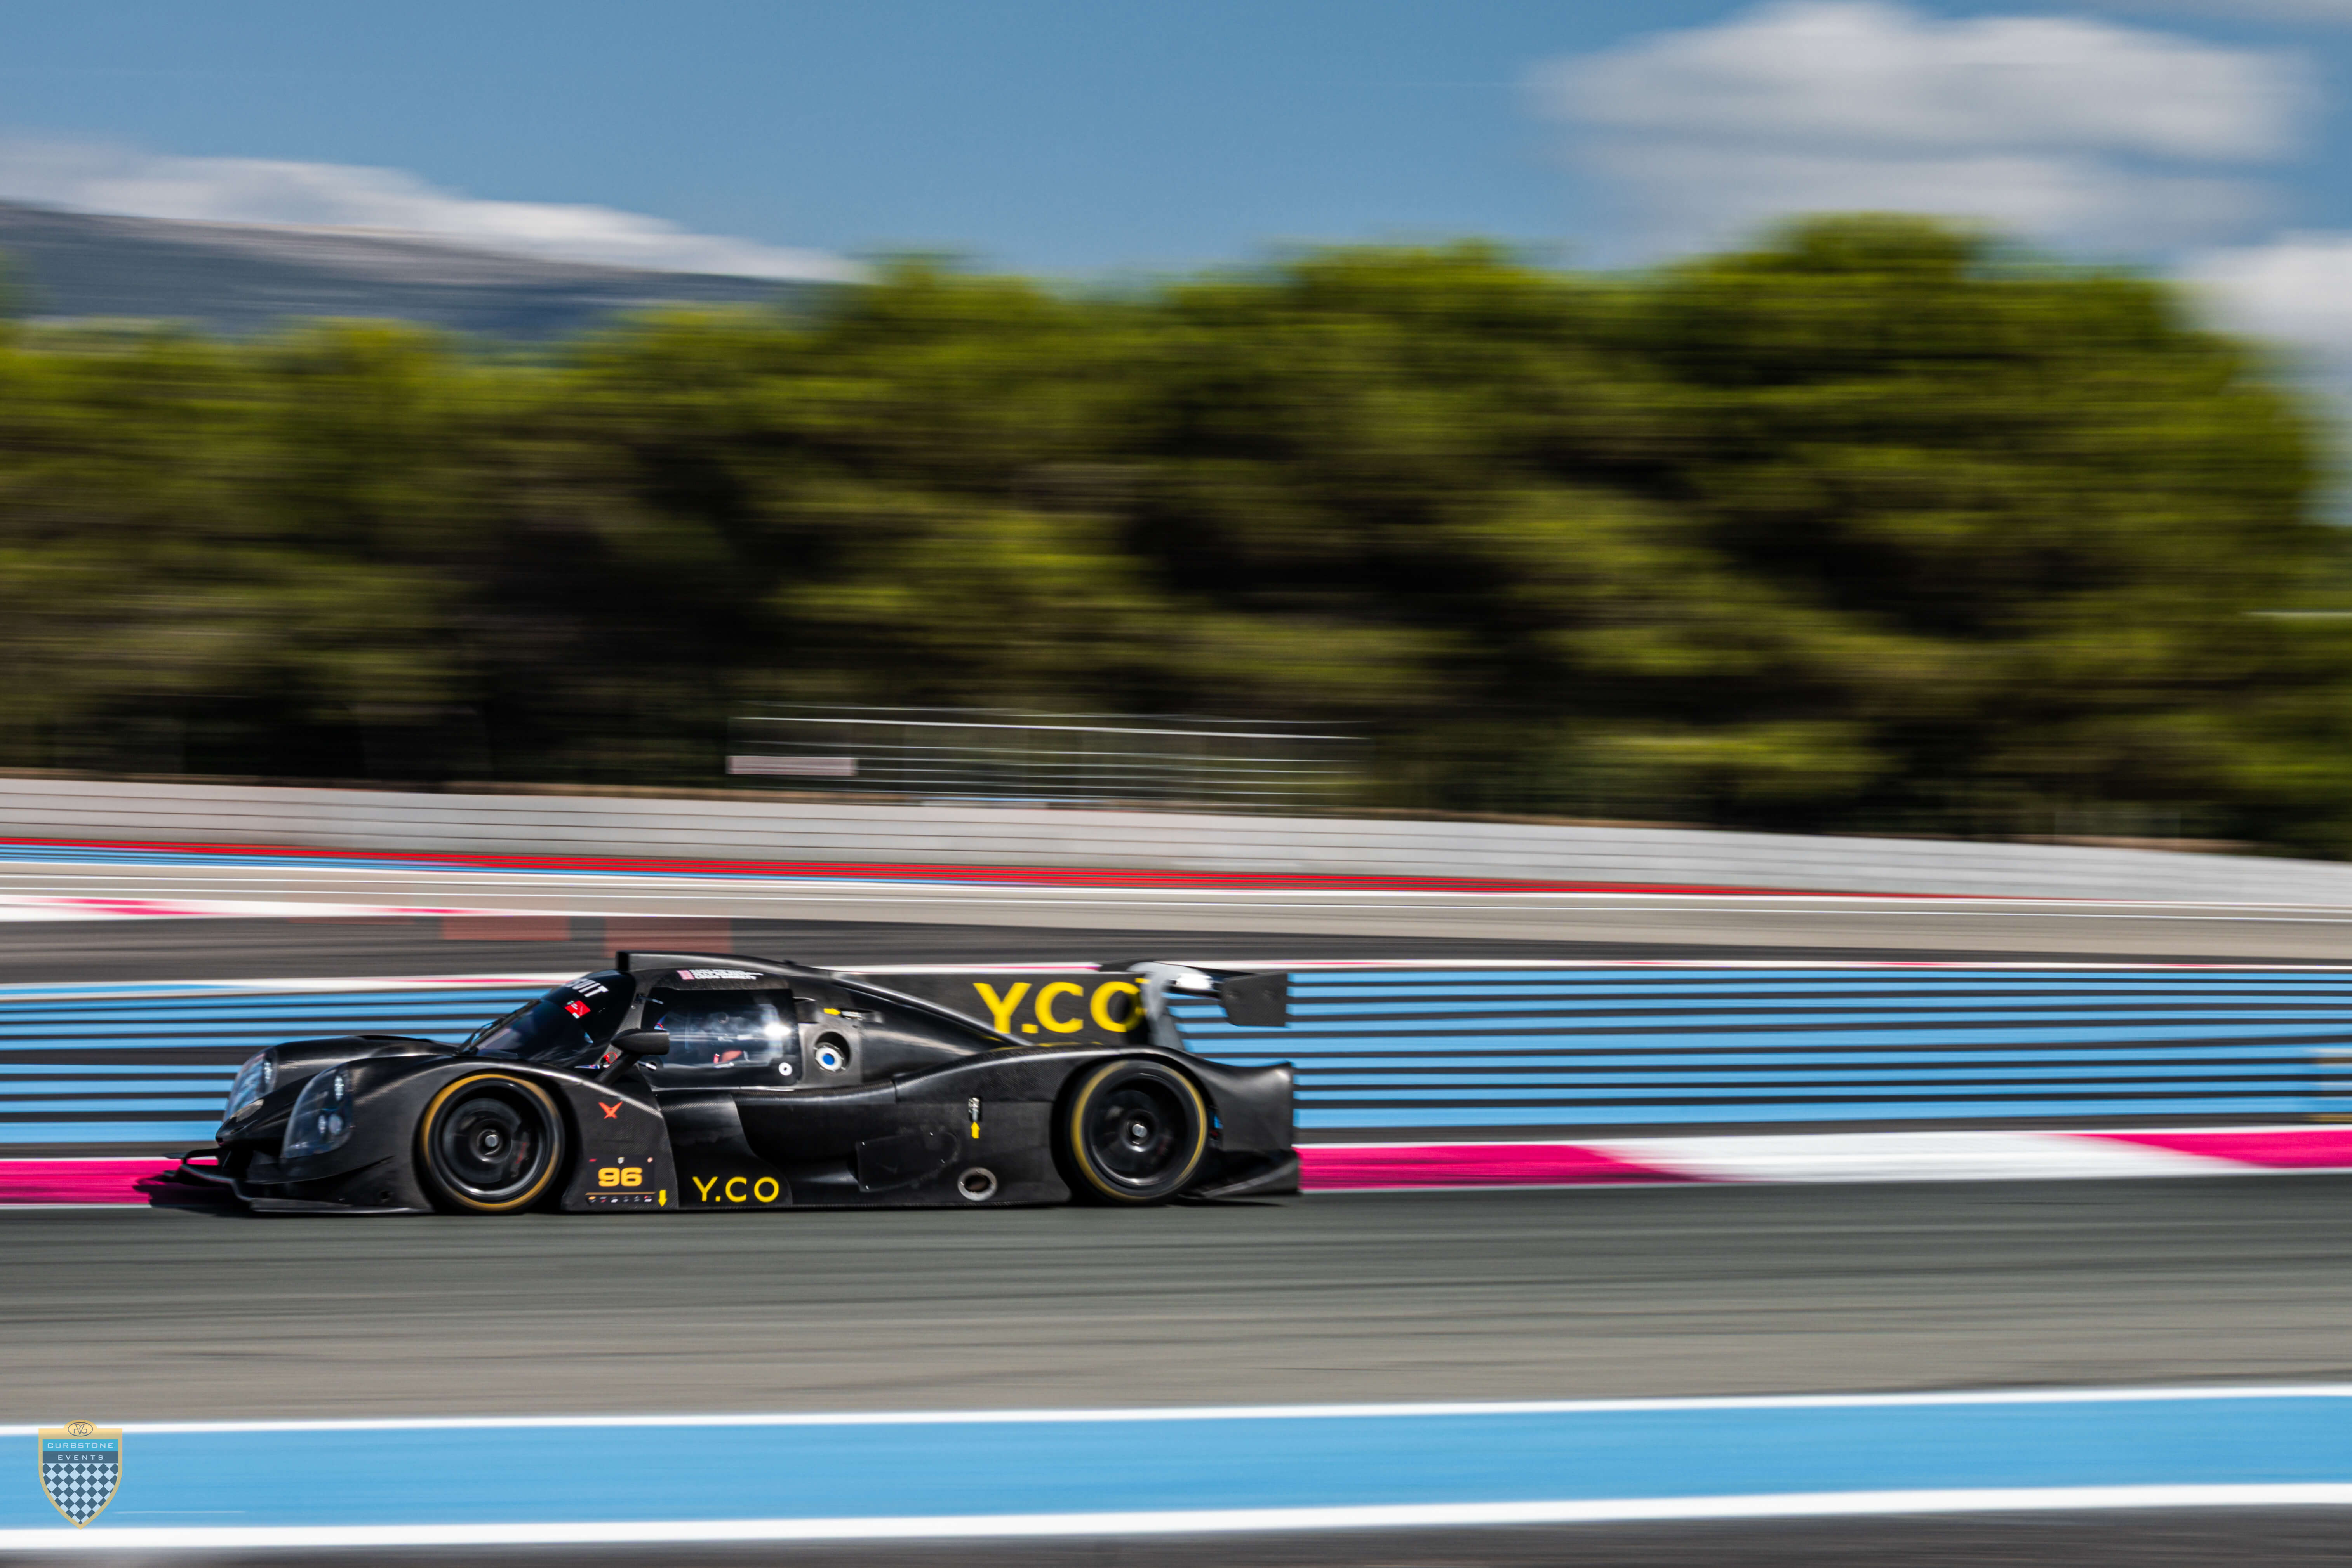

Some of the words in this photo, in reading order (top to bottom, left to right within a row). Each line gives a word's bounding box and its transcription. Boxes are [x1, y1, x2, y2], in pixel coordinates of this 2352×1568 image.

[972, 981, 1146, 1034] Y.CO
[598, 1167, 643, 1187] 96
[692, 1176, 779, 1203] Y.CO
